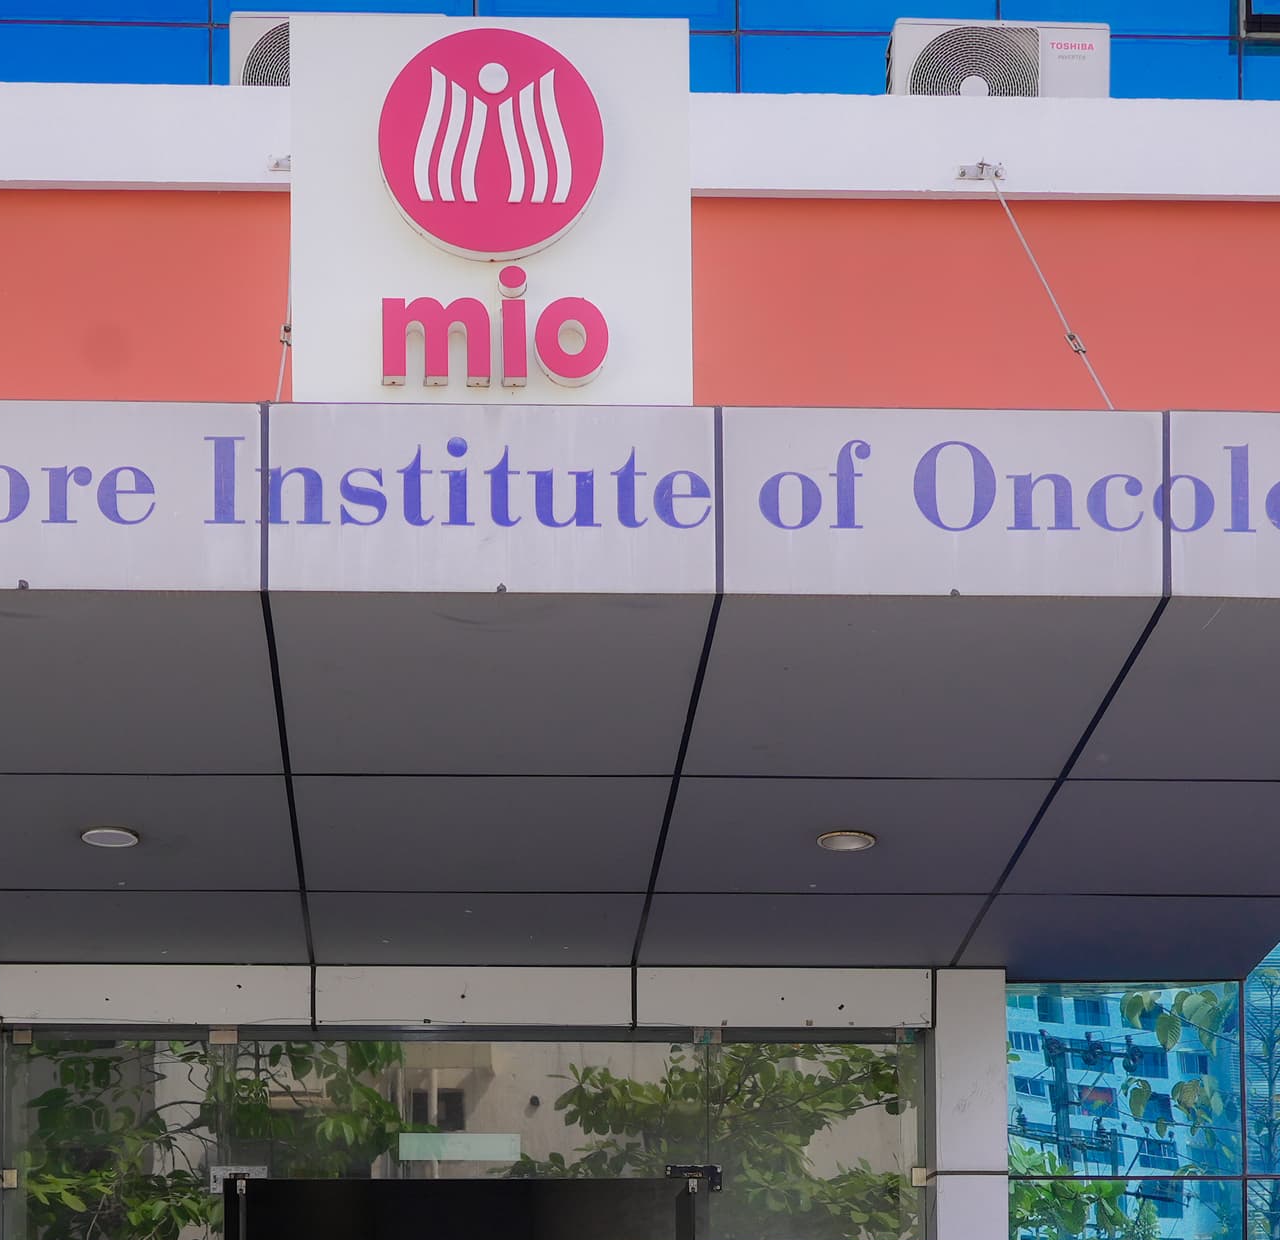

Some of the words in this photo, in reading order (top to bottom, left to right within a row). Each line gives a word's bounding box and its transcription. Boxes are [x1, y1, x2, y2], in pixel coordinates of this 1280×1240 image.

[1050, 41, 1094, 51] TOSHIBA
[382, 264, 609, 384] mio
[204, 436, 714, 532] Institute
[758, 437, 874, 534] of
